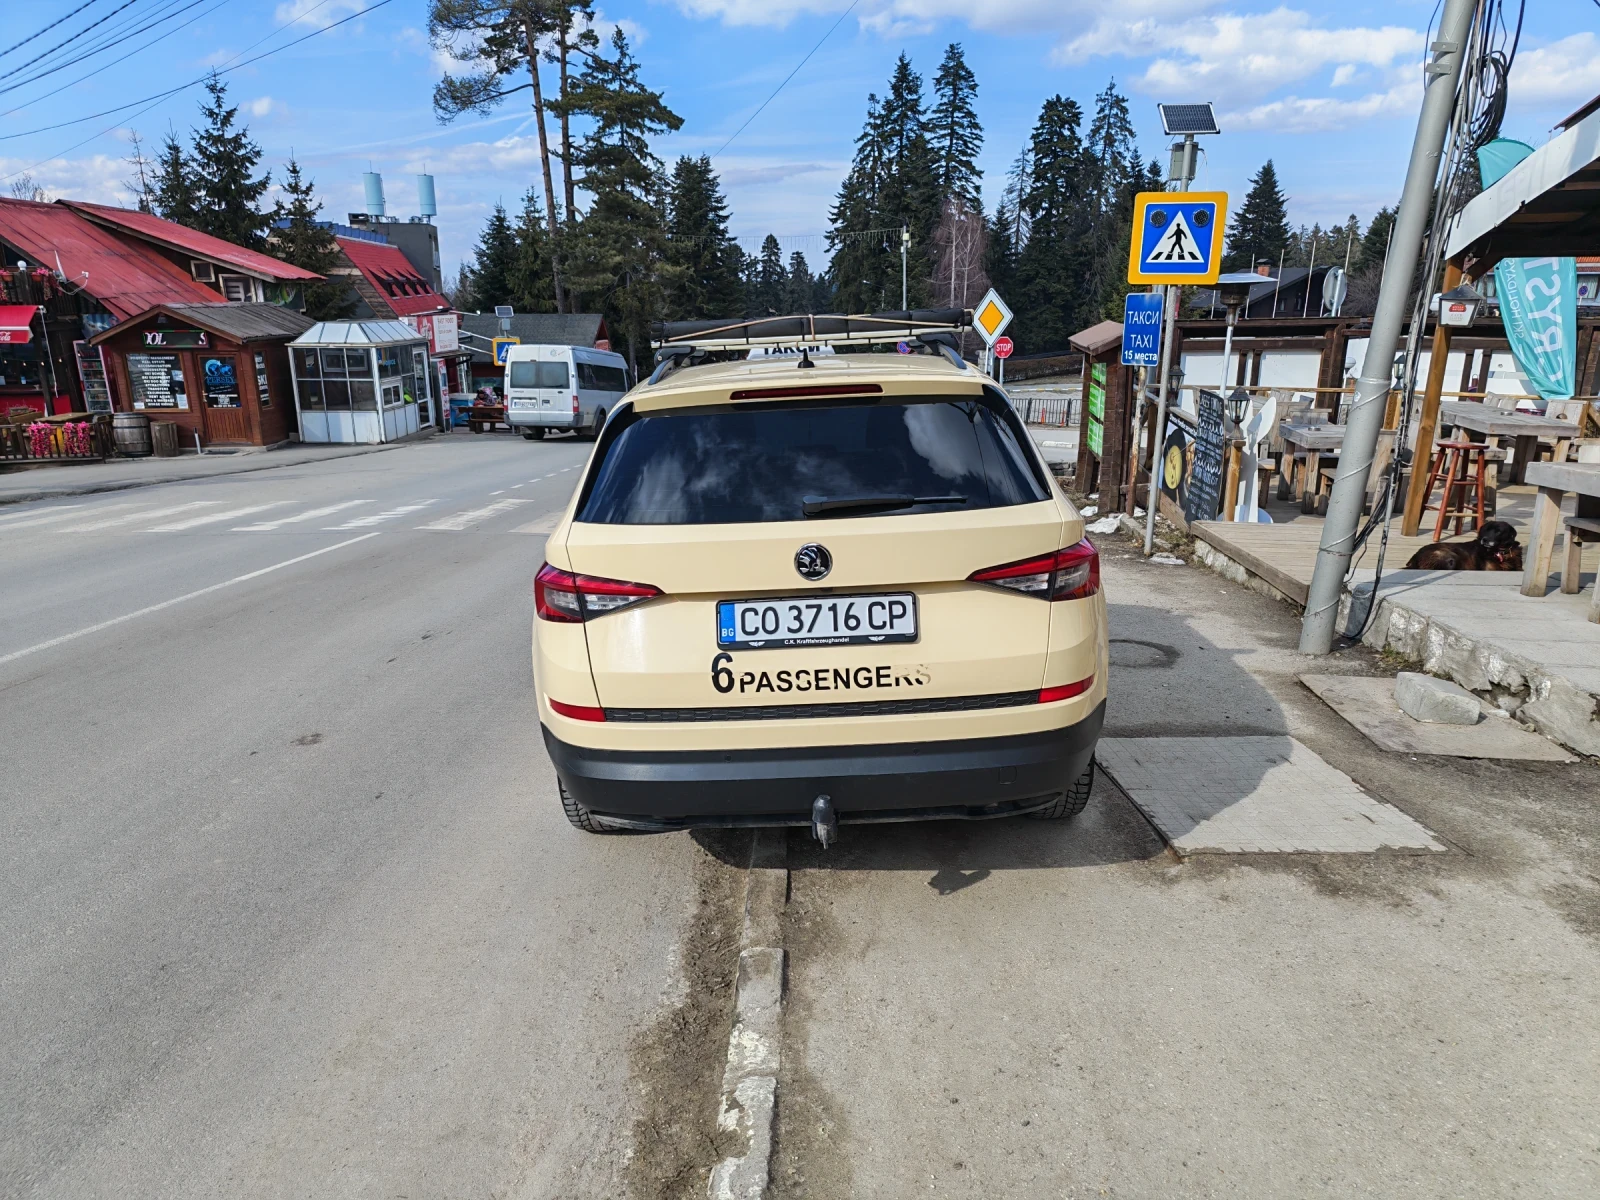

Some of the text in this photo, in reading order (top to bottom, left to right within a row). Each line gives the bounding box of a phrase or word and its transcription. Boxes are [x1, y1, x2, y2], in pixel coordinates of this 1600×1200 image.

[1128, 310, 1160, 325] ТАКСИ
[1130, 334, 1153, 348] TAXI
[1124, 350, 1158, 361] 15 места
[257, 374, 268, 385] SKI
[740, 600, 907, 637] CO 3716 CP
[722, 628, 734, 637] BG
[711, 652, 735, 694] 6
